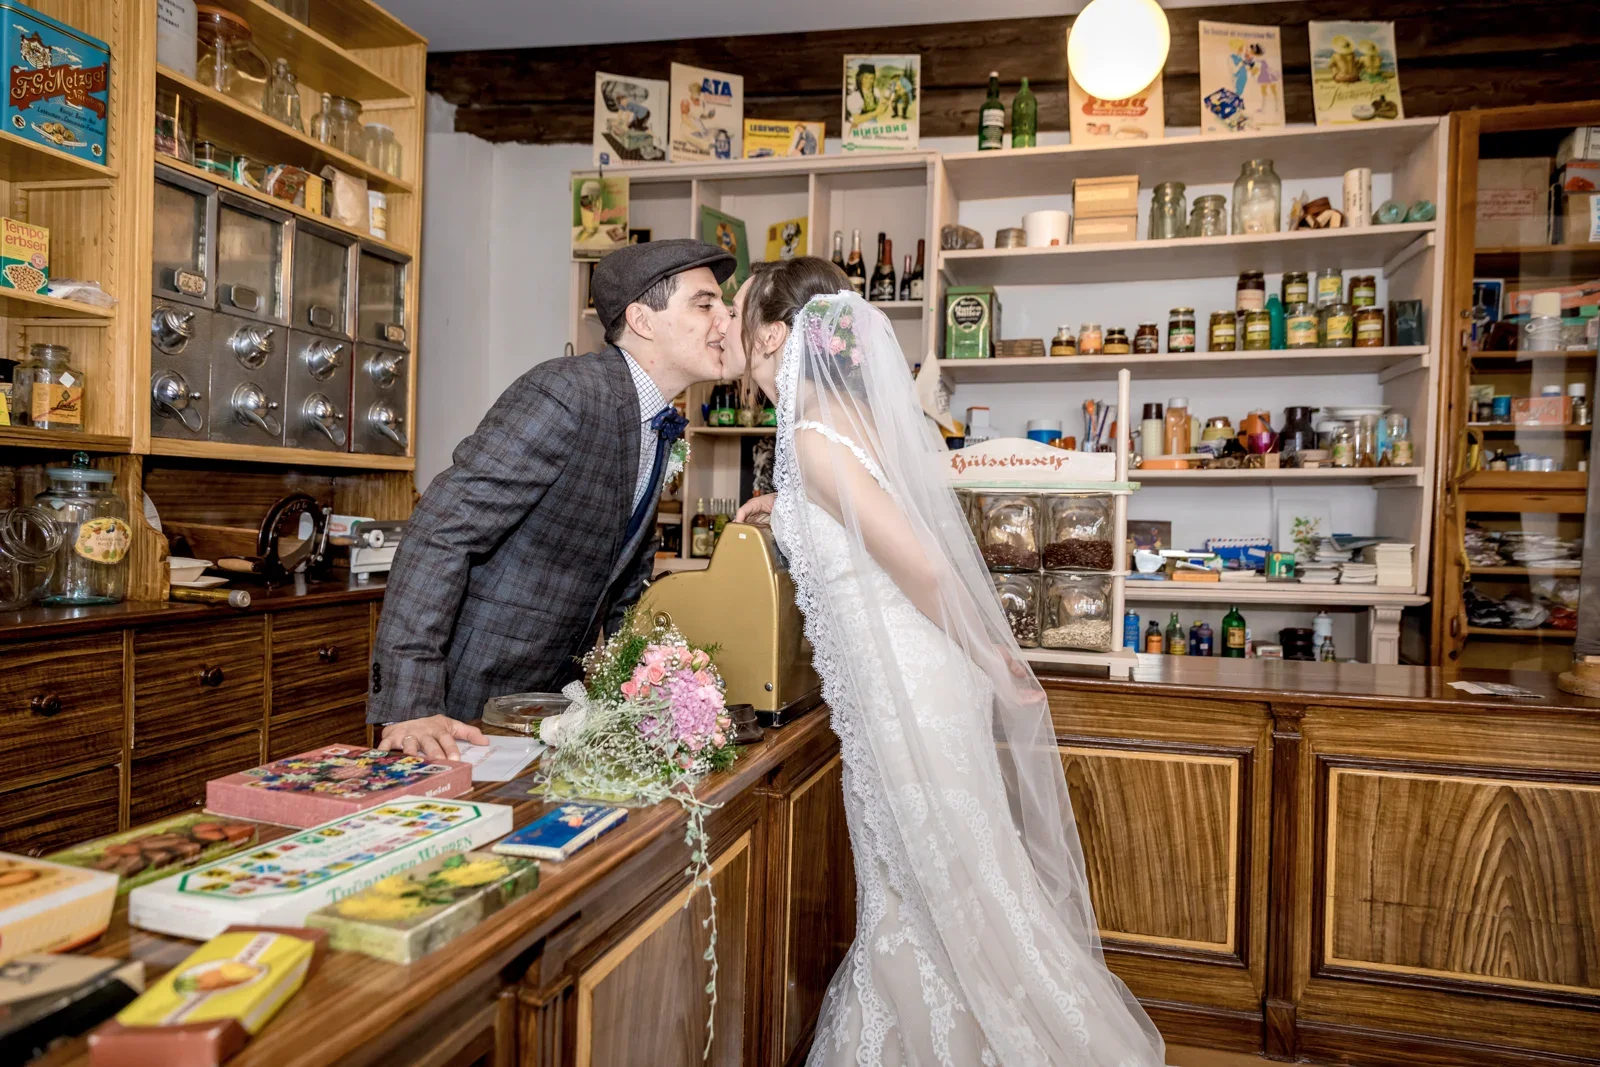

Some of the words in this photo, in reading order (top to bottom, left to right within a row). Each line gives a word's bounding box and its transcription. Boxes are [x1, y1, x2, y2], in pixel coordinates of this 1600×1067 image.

[701, 77, 733, 98] ATA
[4, 218, 48, 240] Tempo-
[5, 234, 47, 252] erbsen
